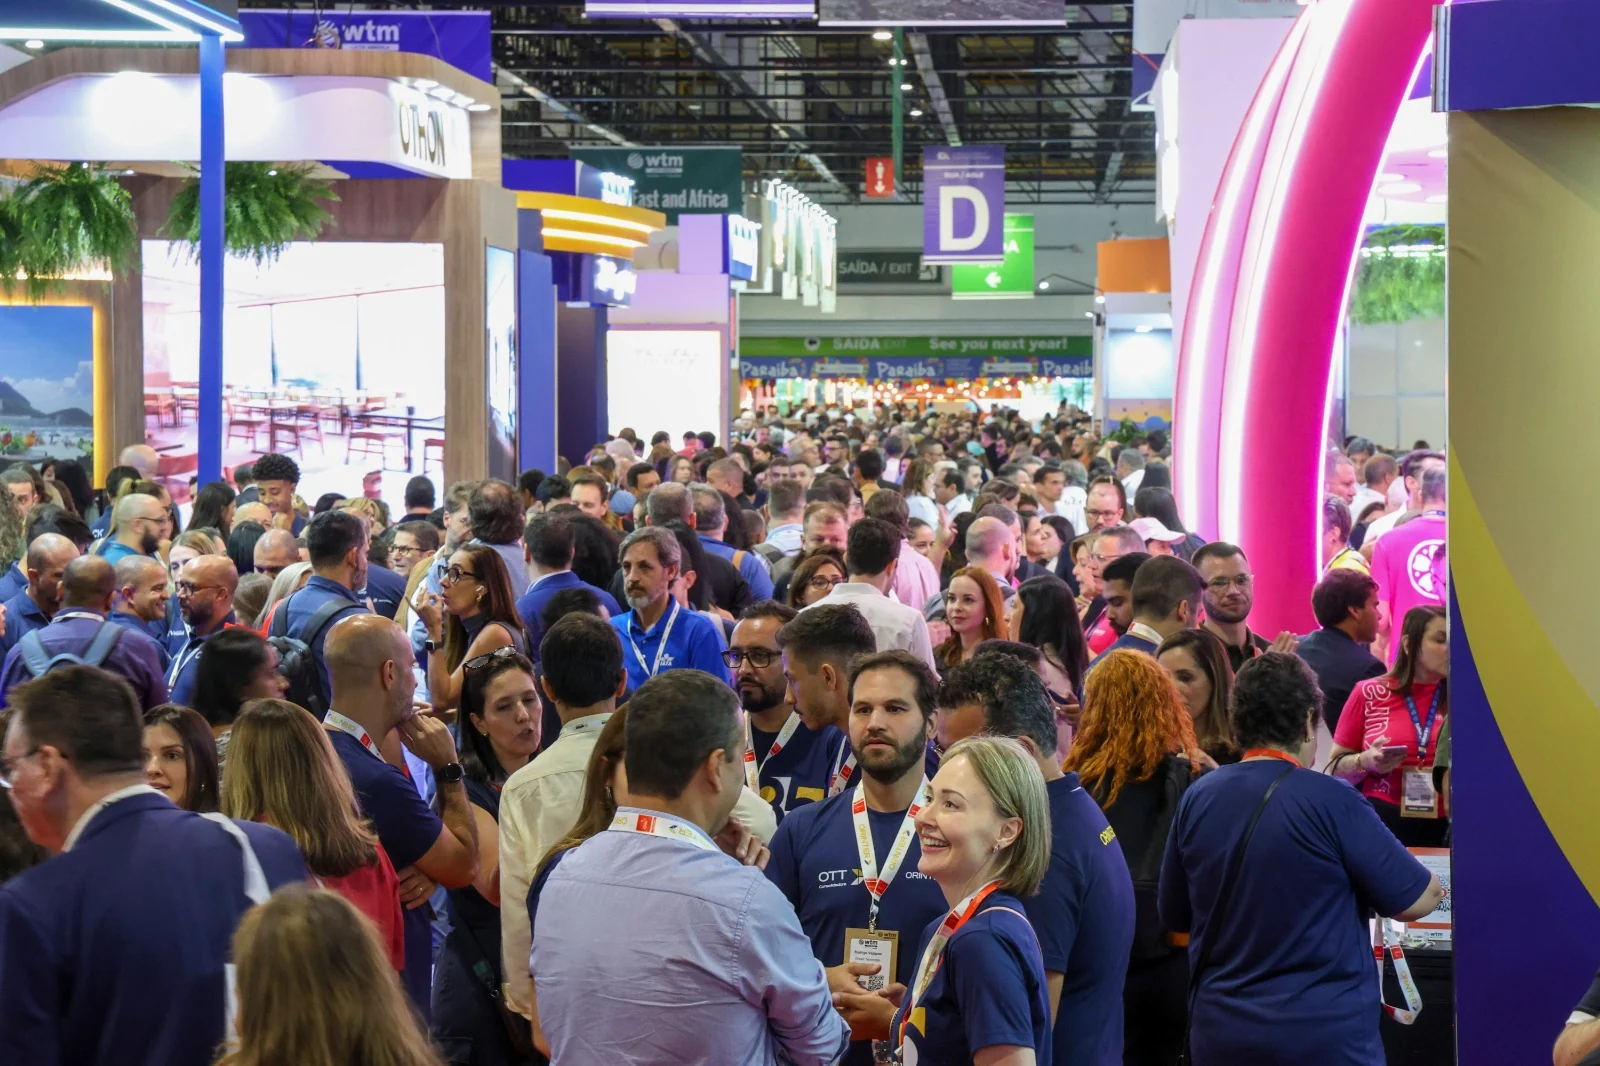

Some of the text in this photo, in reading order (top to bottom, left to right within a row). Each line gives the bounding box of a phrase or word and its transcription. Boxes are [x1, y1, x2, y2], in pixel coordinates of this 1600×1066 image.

[342, 20, 400, 41] wtm
[399, 100, 446, 167] OTHON
[645, 152, 683, 167] wtm
[662, 189, 687, 208] and
[689, 189, 729, 208] Africa
[939, 185, 989, 251] D
[889, 263, 913, 274] EXIT
[929, 338, 1068, 352] See you next year!
[859, 824, 871, 859] ORINTER
[889, 836, 908, 871] ORINTER
[818, 869, 848, 882] OTT
